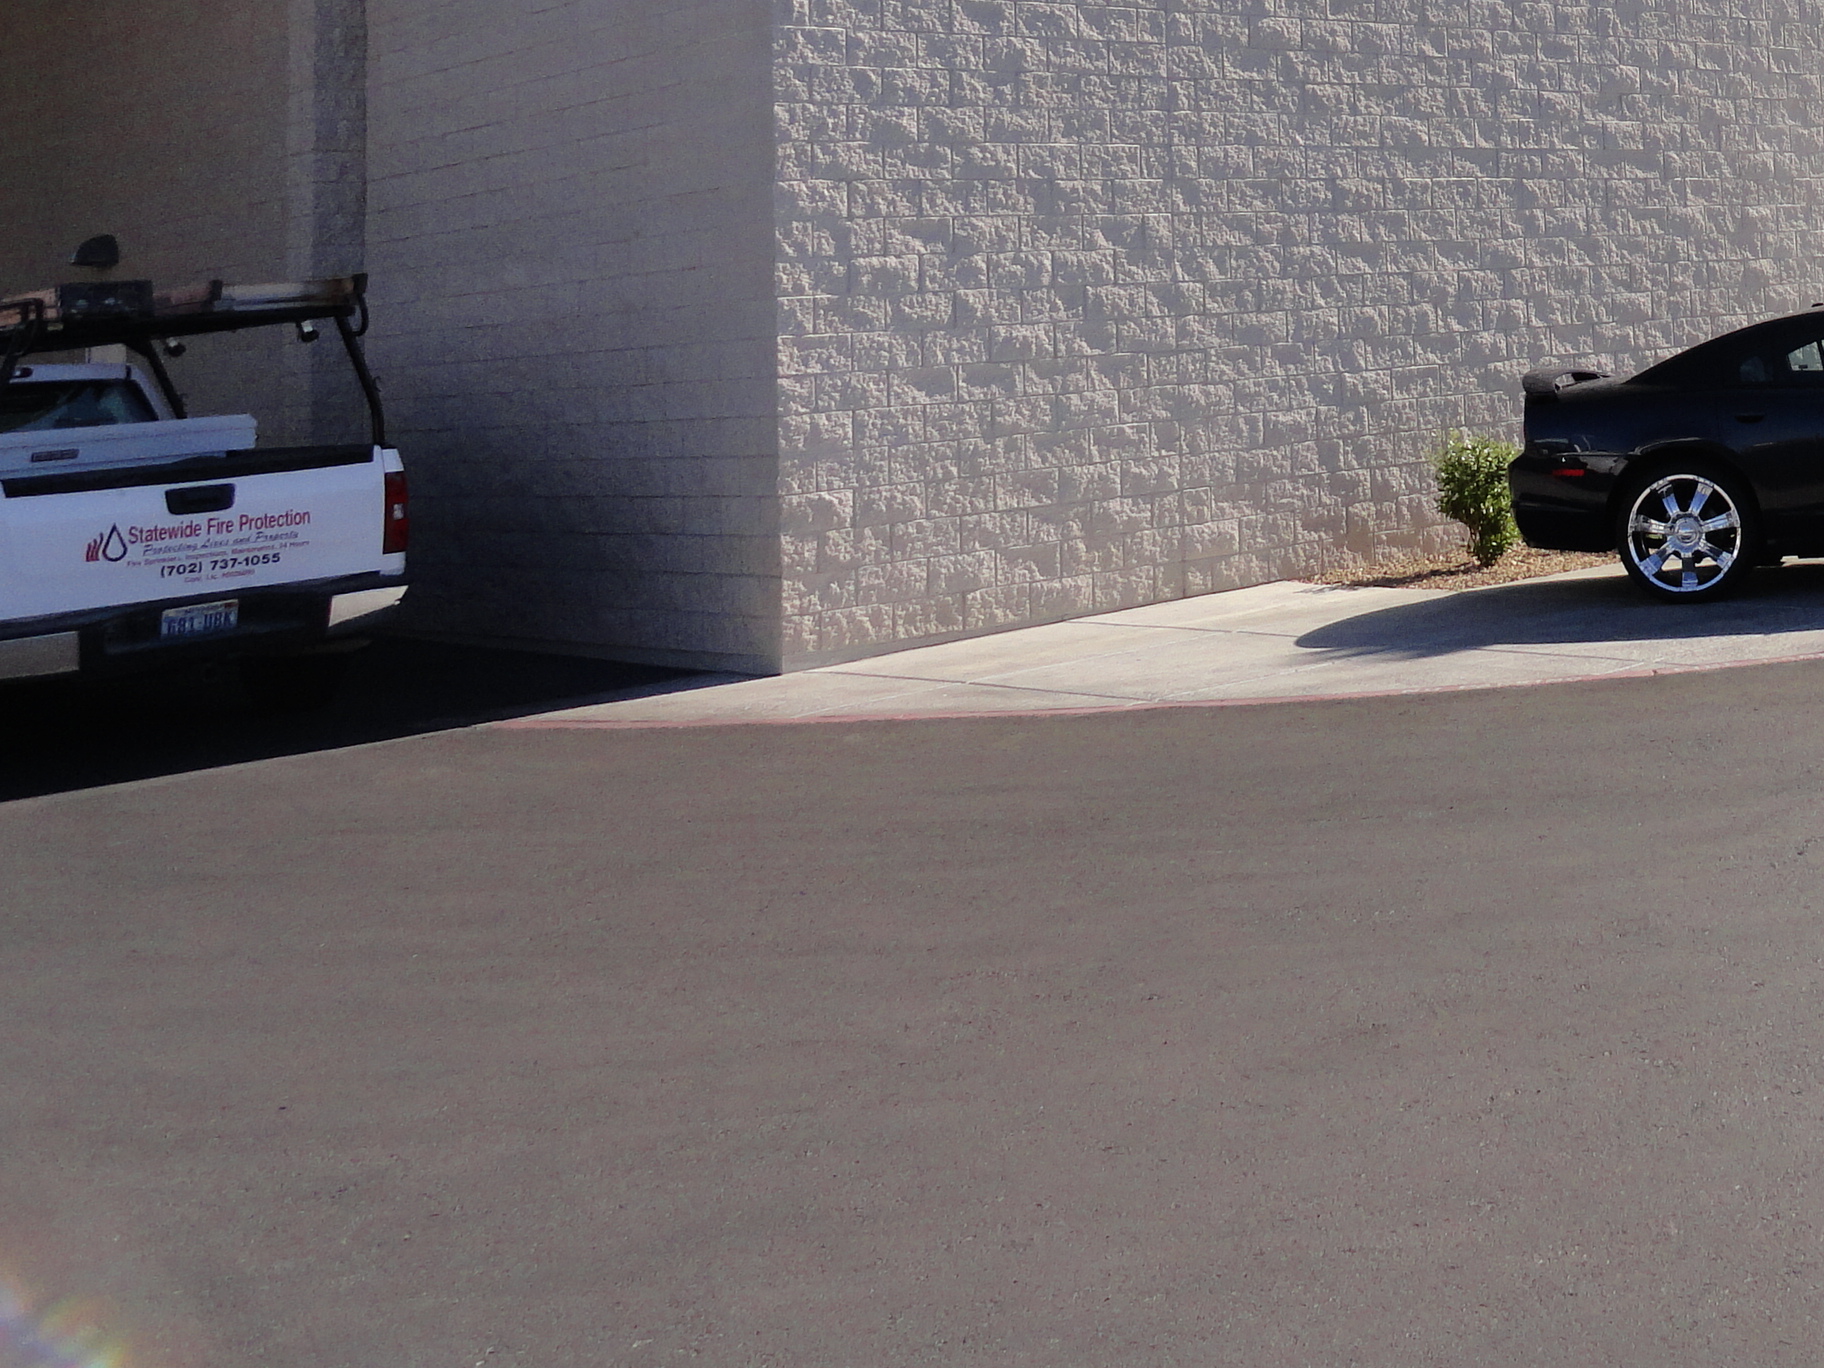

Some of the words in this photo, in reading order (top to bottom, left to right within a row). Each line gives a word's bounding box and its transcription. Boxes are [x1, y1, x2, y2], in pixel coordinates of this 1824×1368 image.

[128, 519, 202, 545] Statewide
[207, 518, 234, 535] Fire
[239, 509, 311, 532] Protection
[161, 561, 202, 579] (702)
[210, 552, 281, 571] 737-1055
